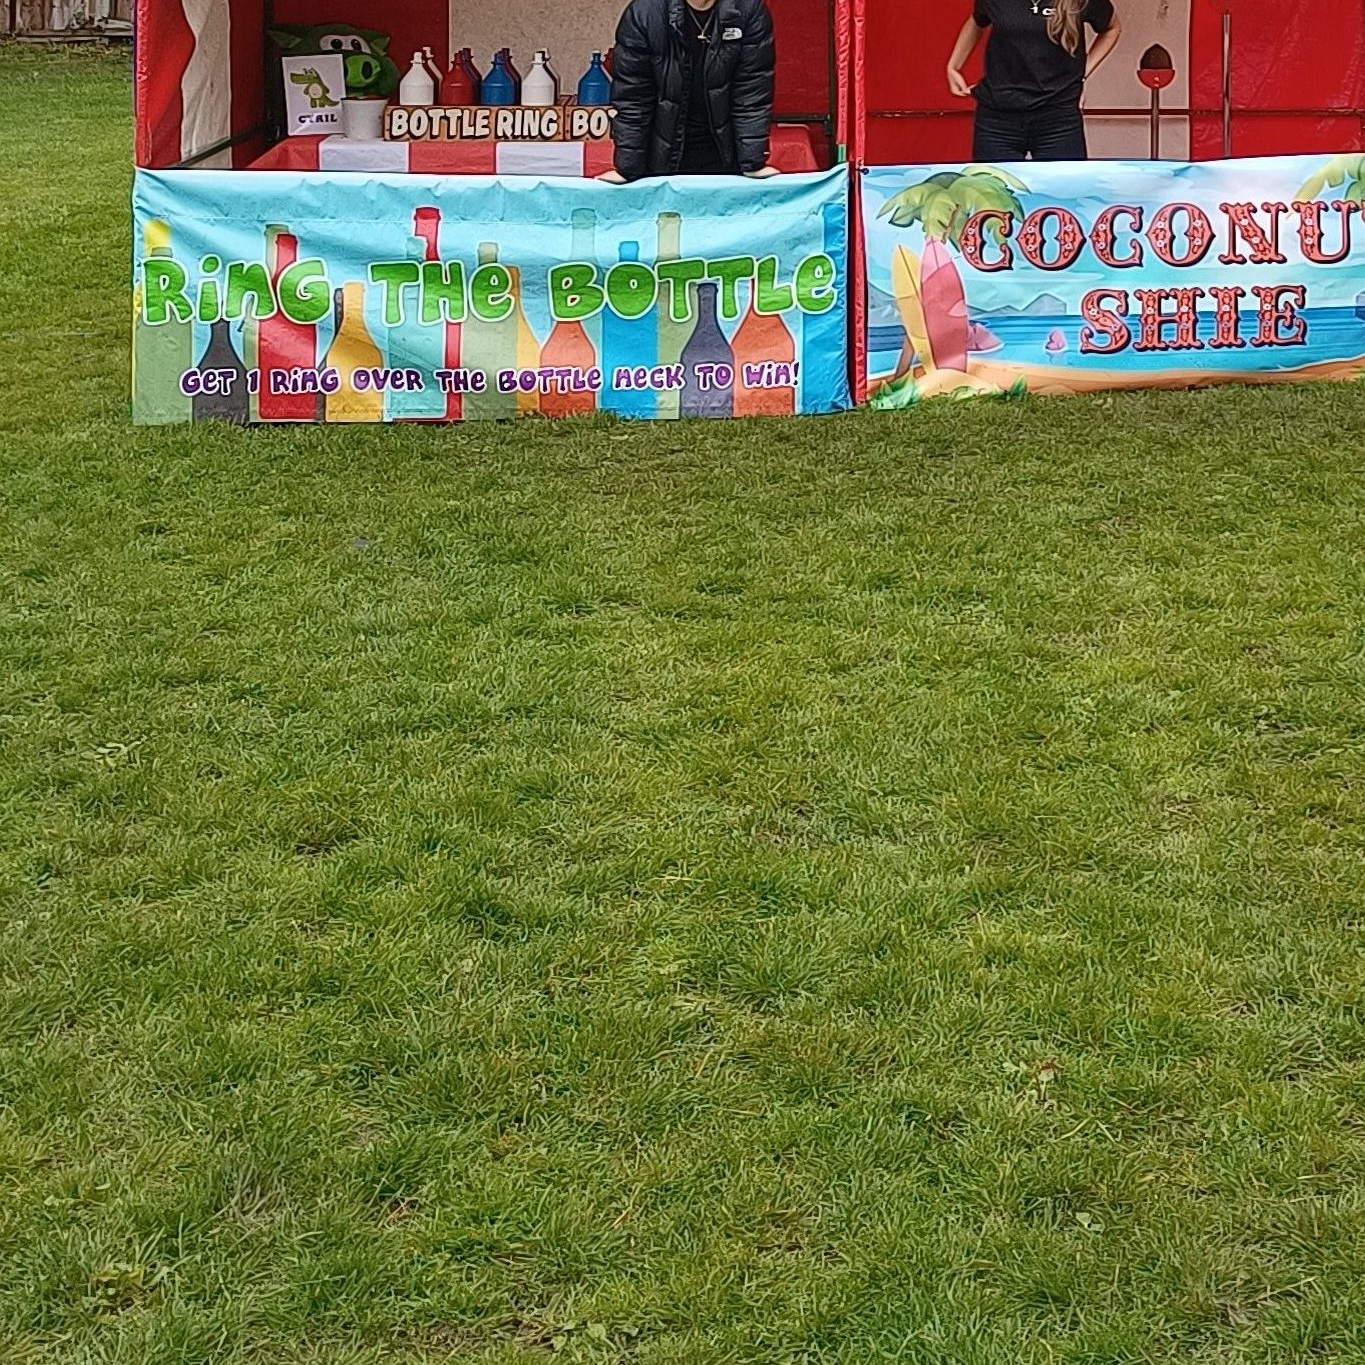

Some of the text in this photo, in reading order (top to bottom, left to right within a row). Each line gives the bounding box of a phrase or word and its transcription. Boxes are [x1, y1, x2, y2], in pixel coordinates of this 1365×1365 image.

[390, 108, 559, 139] BOTTLE RING
[1079, 283, 1309, 355] SHIE
[246, 369, 258, 393] 1
[696, 364, 735, 392] TO
